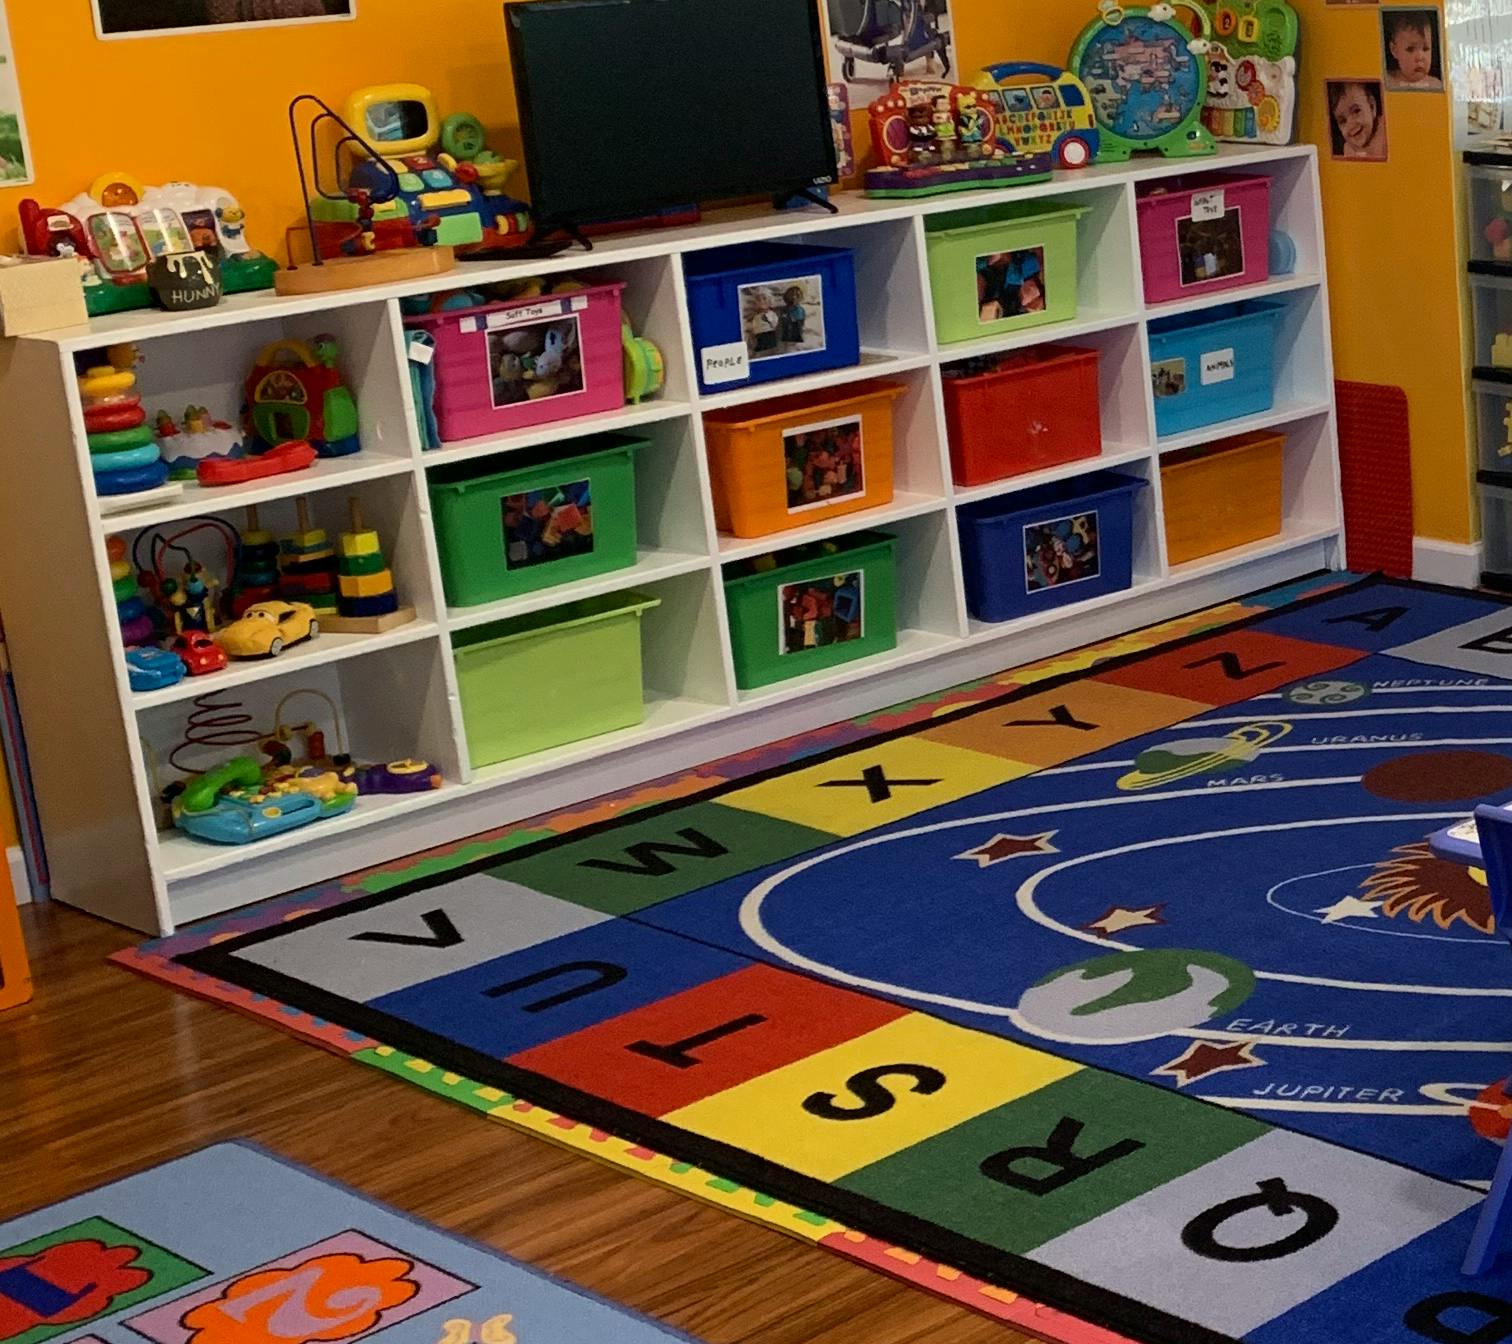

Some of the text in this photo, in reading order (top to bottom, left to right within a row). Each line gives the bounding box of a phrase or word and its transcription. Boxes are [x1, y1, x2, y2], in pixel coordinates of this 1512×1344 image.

[171, 282, 220, 304] HUNNY
[1327, 607, 1408, 632] A
[1184, 652, 1284, 680] Z
[1373, 677, 1489, 689] NEPTUNE
[1005, 705, 1098, 730] Y
[1311, 732, 1424, 745] URANUS
[818, 765, 941, 803] X
[1207, 773, 1286, 788] MARS
[577, 828, 729, 876] W
[349, 909, 464, 948] V
[484, 961, 627, 1013] U
[626, 1014, 767, 1068] T
[1226, 1018, 1350, 1039] EARTH
[802, 1064, 946, 1120] S
[1253, 1082, 1405, 1103] JUPITER
[979, 1116, 1146, 1196] R
[1181, 1177, 1339, 1262] Q
[0, 1255, 96, 1318] 1
[218, 1265, 384, 1339] 2
